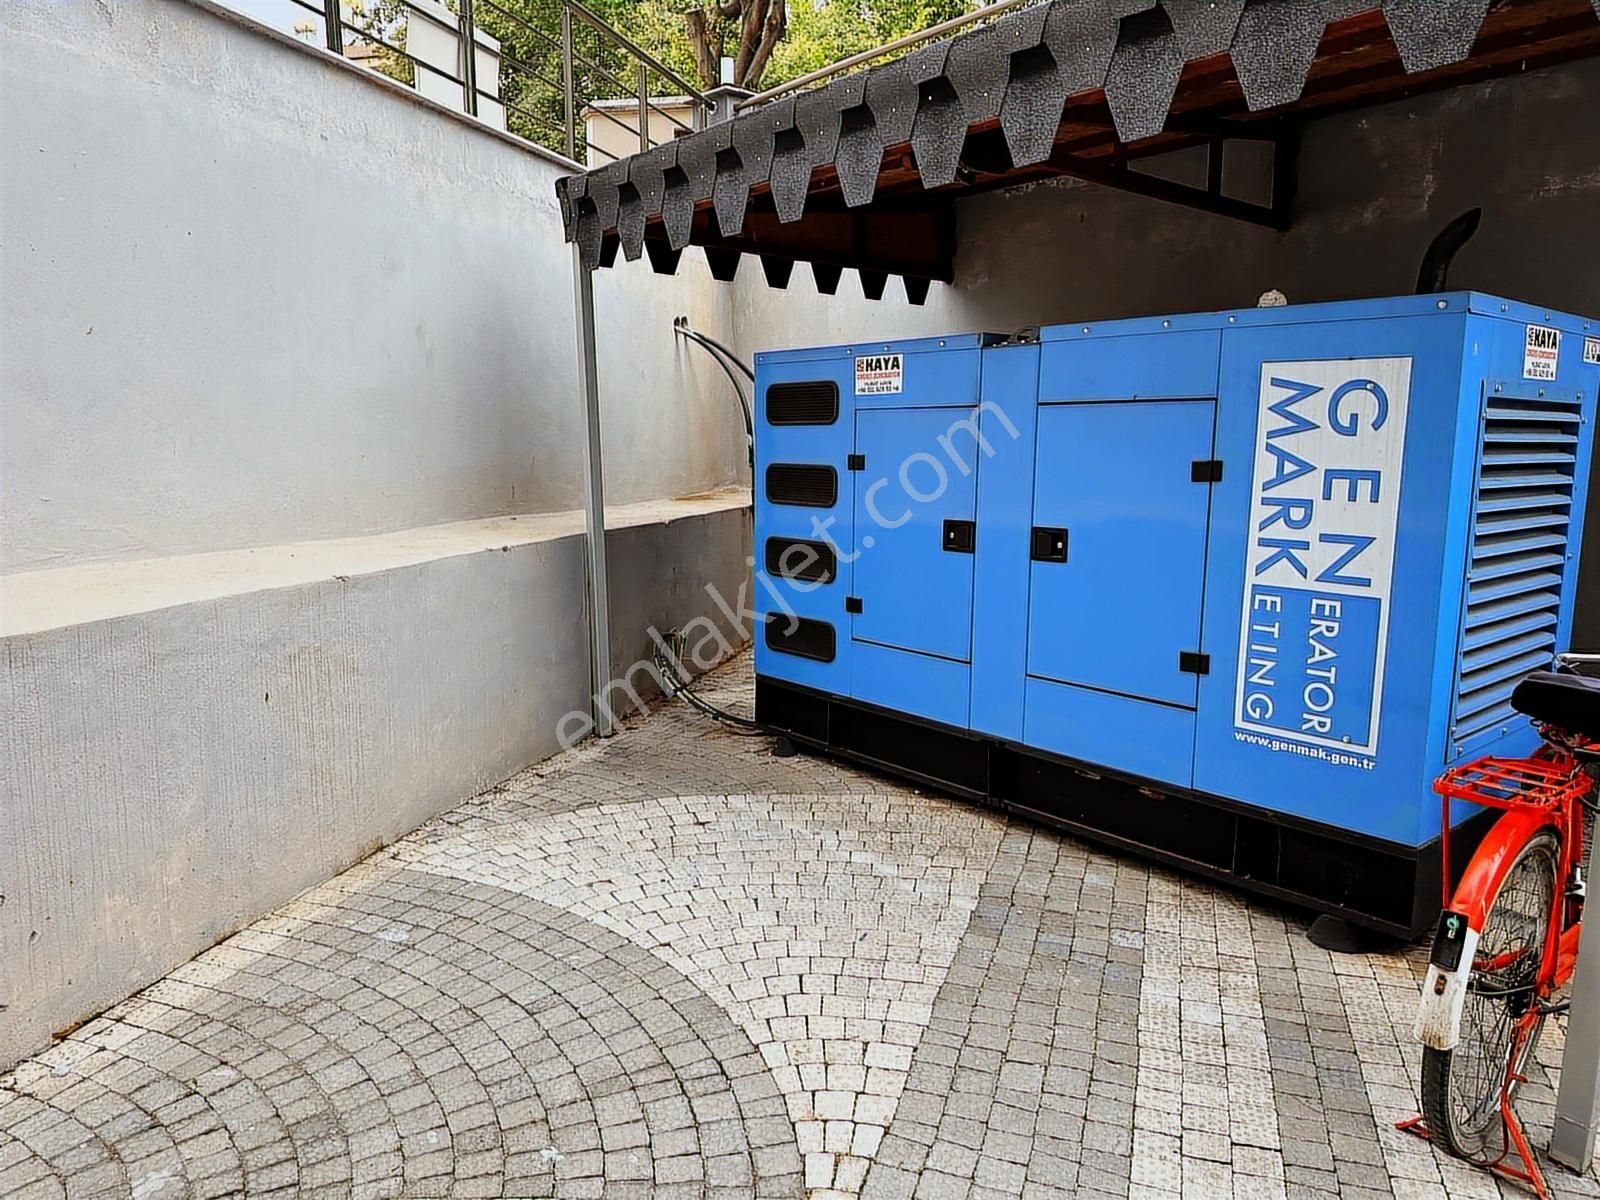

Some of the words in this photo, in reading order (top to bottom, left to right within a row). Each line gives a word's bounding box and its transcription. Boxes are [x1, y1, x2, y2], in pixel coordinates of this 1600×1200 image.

[1534, 327, 1557, 349] KAYA
[865, 356, 900, 372] KAYA
[1234, 731, 1376, 770] www.genmak.gen.tr
